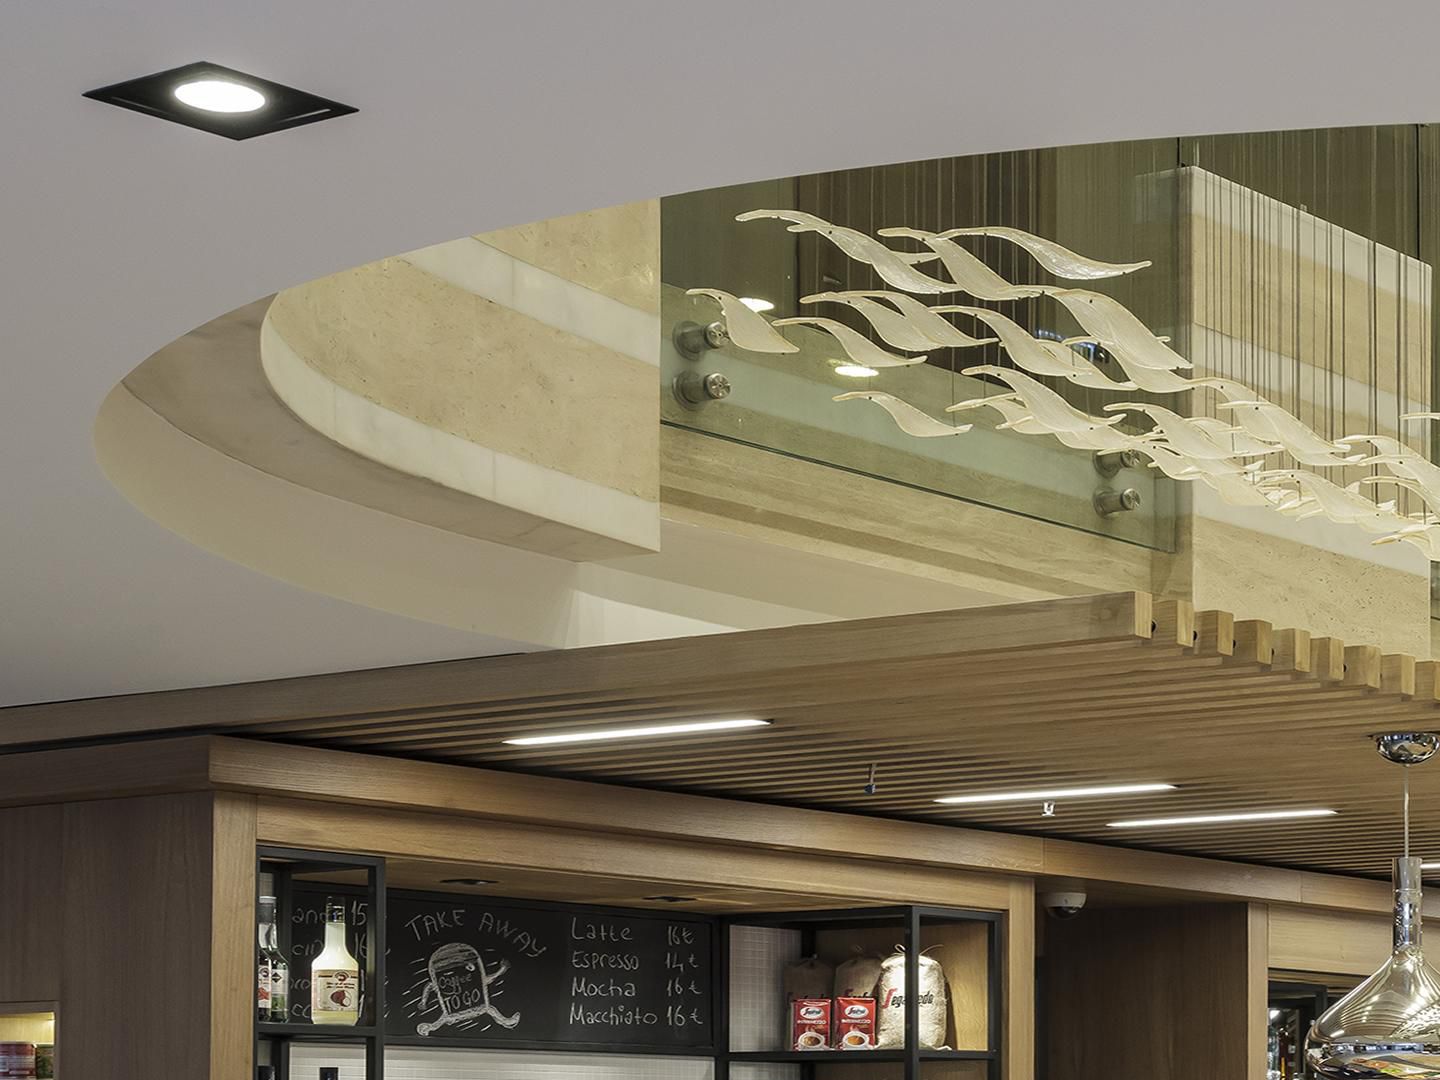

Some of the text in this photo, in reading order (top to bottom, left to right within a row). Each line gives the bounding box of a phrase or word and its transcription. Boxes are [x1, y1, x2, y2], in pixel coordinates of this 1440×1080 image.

[404, 909, 547, 957] TAKE AWAY
[571, 917, 633, 941] Latte
[571, 950, 639, 971] Espresso
[571, 976, 636, 997] Mocha
[882, 987, 934, 1009] Segedo
[569, 1002, 658, 1026] Macchiato
